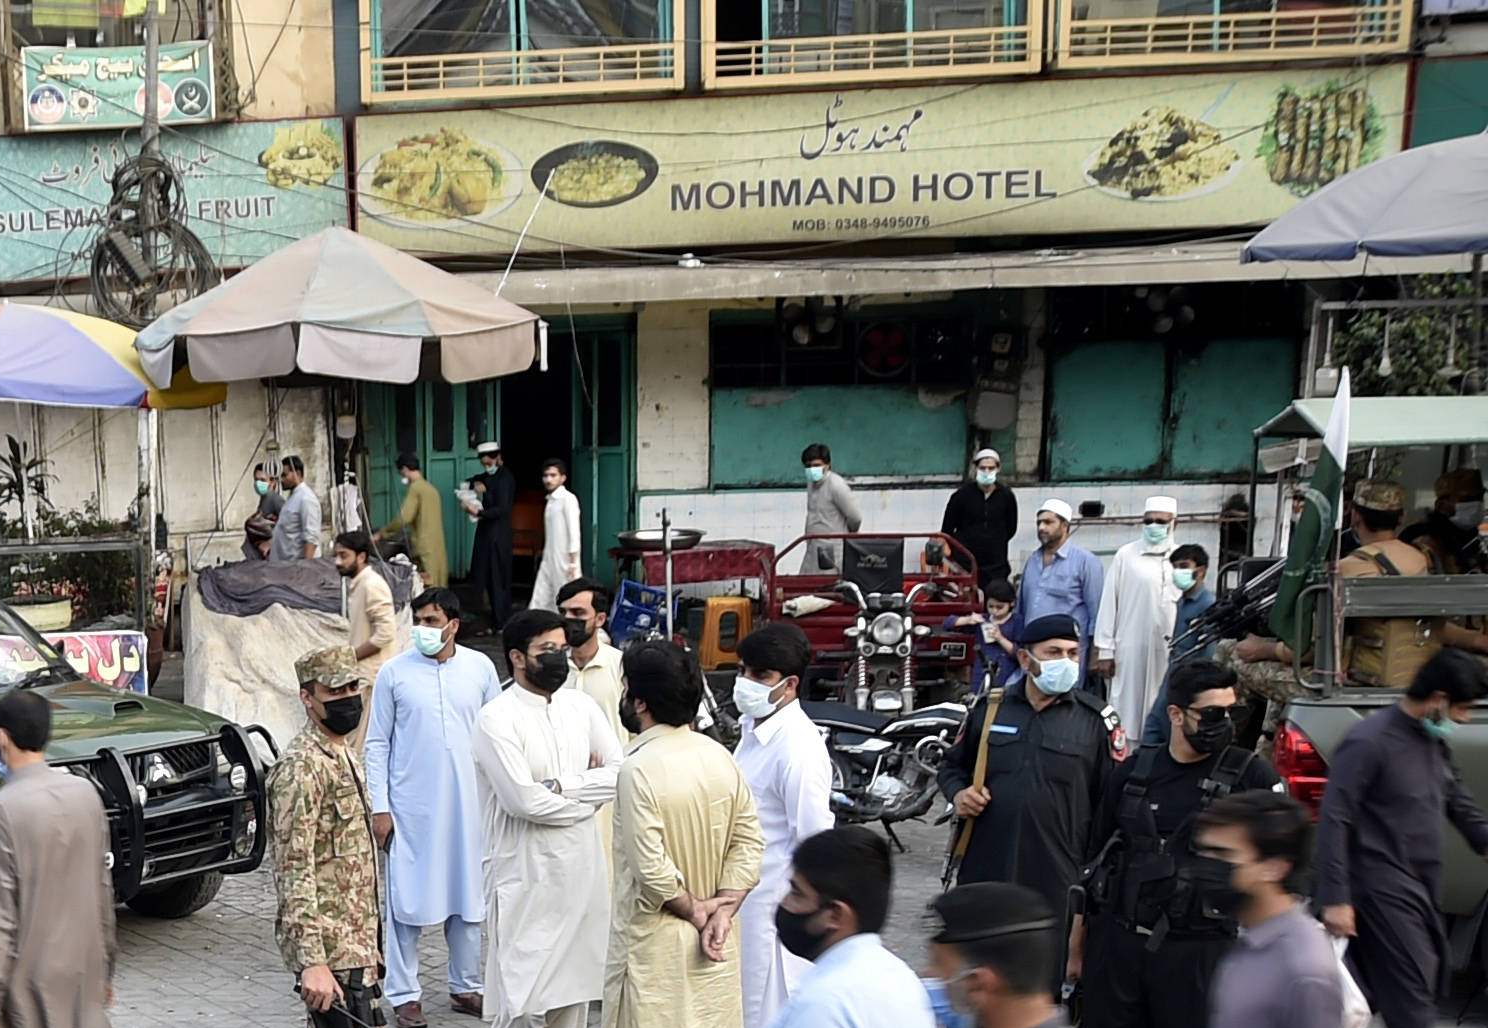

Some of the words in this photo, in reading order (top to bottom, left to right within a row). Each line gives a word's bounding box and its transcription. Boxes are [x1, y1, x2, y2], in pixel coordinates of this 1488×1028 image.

[799, 93, 861, 161] ہوٹل
[861, 108, 924, 153] مہمند
[40, 144, 102, 187] فروٹ
[197, 195, 277, 221] FRUIT
[670, 176, 896, 212] MOHMAND
[912, 169, 1058, 203] HOTEL
[792, 218, 831, 232] MOB:
[835, 215, 930, 231] 0348-9495076
[97, 637, 142, 682] دل
